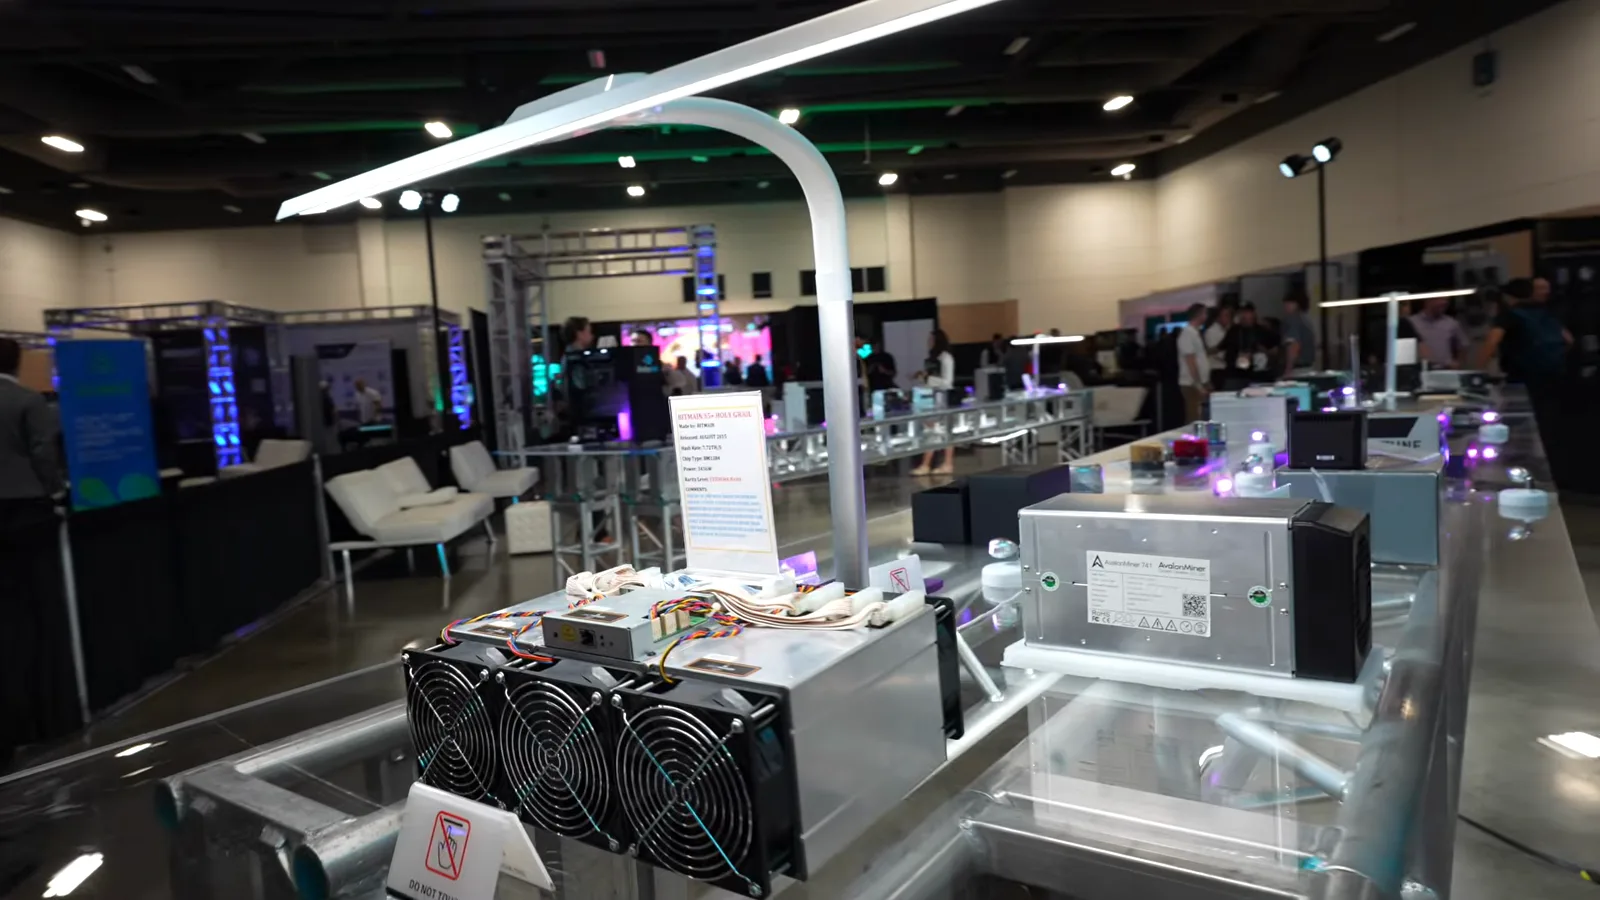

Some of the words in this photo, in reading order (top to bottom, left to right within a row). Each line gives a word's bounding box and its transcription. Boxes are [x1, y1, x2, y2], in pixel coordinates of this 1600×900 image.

[1158, 562, 1206, 572] AvalonMiner
[409, 879, 420, 891] DO
[421, 884, 438, 899] NOT
